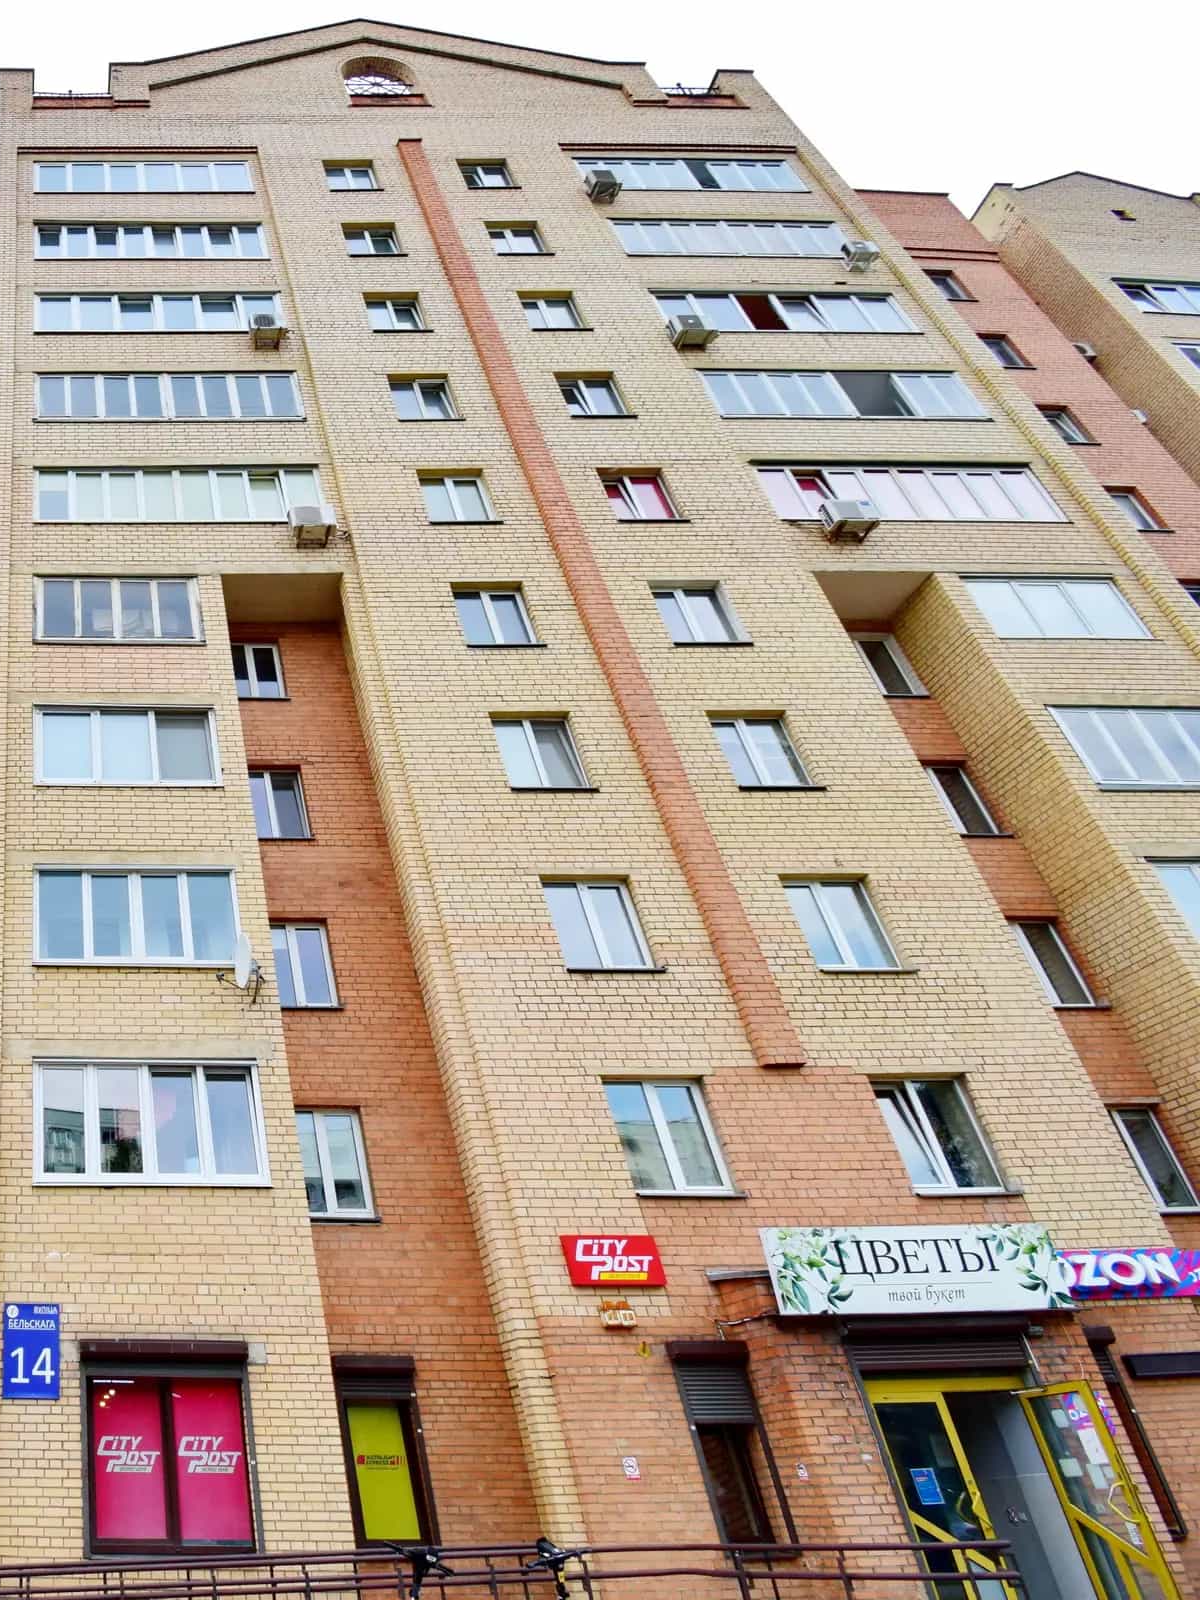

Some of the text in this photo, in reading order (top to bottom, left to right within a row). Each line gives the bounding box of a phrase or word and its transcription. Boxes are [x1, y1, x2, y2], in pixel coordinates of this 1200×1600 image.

[591, 1256, 653, 1280] POST
[830, 1237, 1000, 1282] ЦВЕТЫ
[888, 1285, 966, 1305] твой букет
[8, 1319, 56, 1329] БЕЛЬСКАГА
[10, 1346, 55, 1385] 14
[106, 1451, 160, 1473] POST
[188, 1451, 242, 1473] POST
